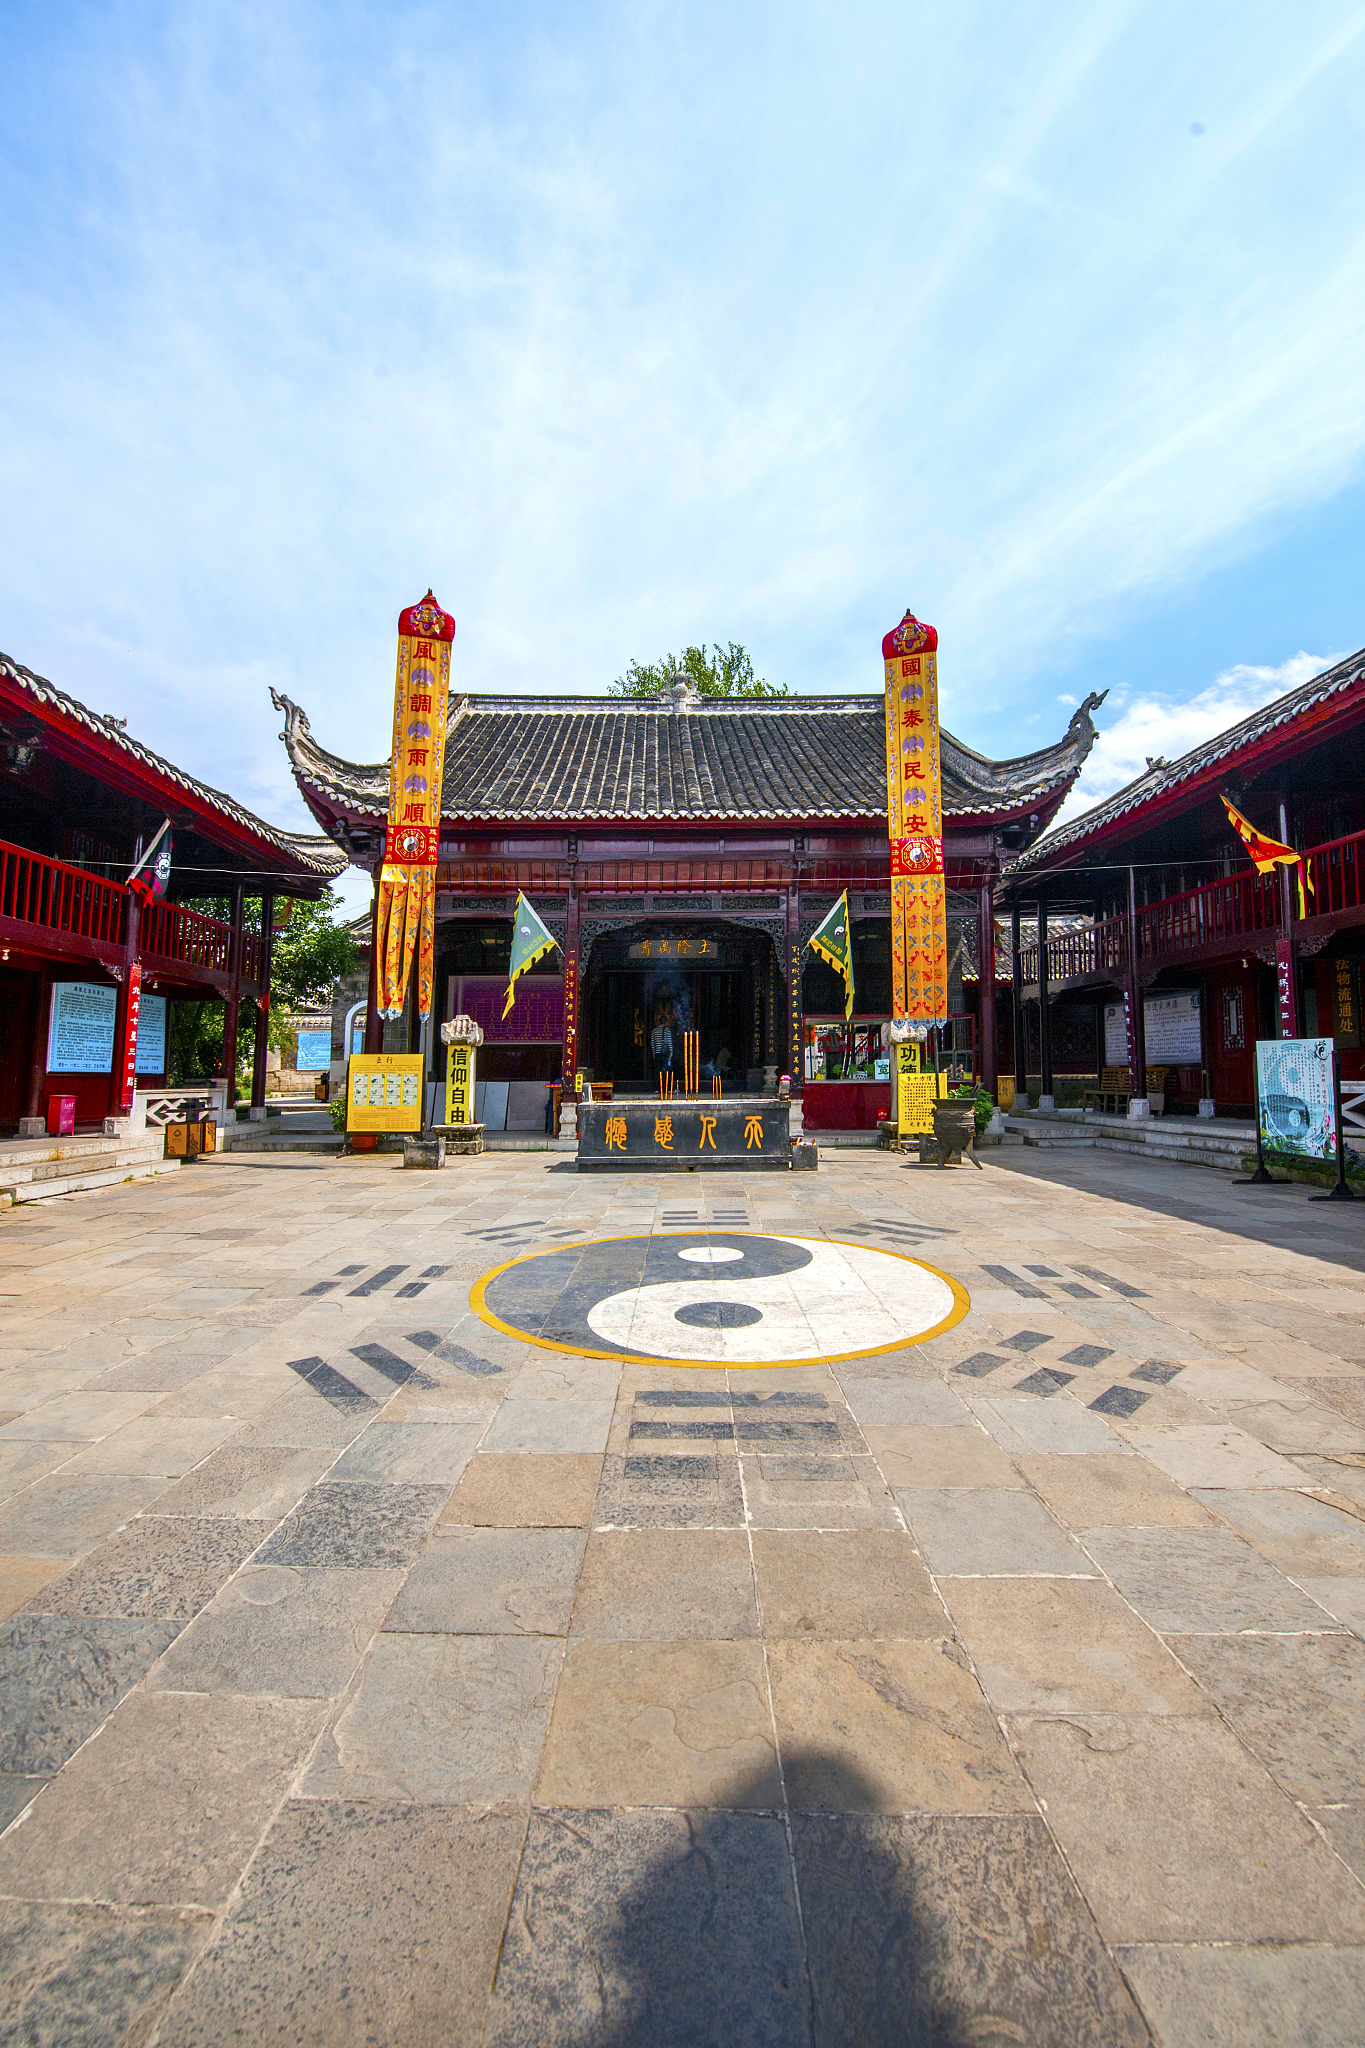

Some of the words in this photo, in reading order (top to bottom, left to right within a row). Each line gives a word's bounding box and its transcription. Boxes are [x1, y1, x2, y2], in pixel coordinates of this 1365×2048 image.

[402, 640, 437, 823] 風調雨順
[901, 657, 928, 834] 國泰民安
[1335, 959, 1354, 1033] 法物流通处
[450, 1048, 468, 1124] 信仰自由
